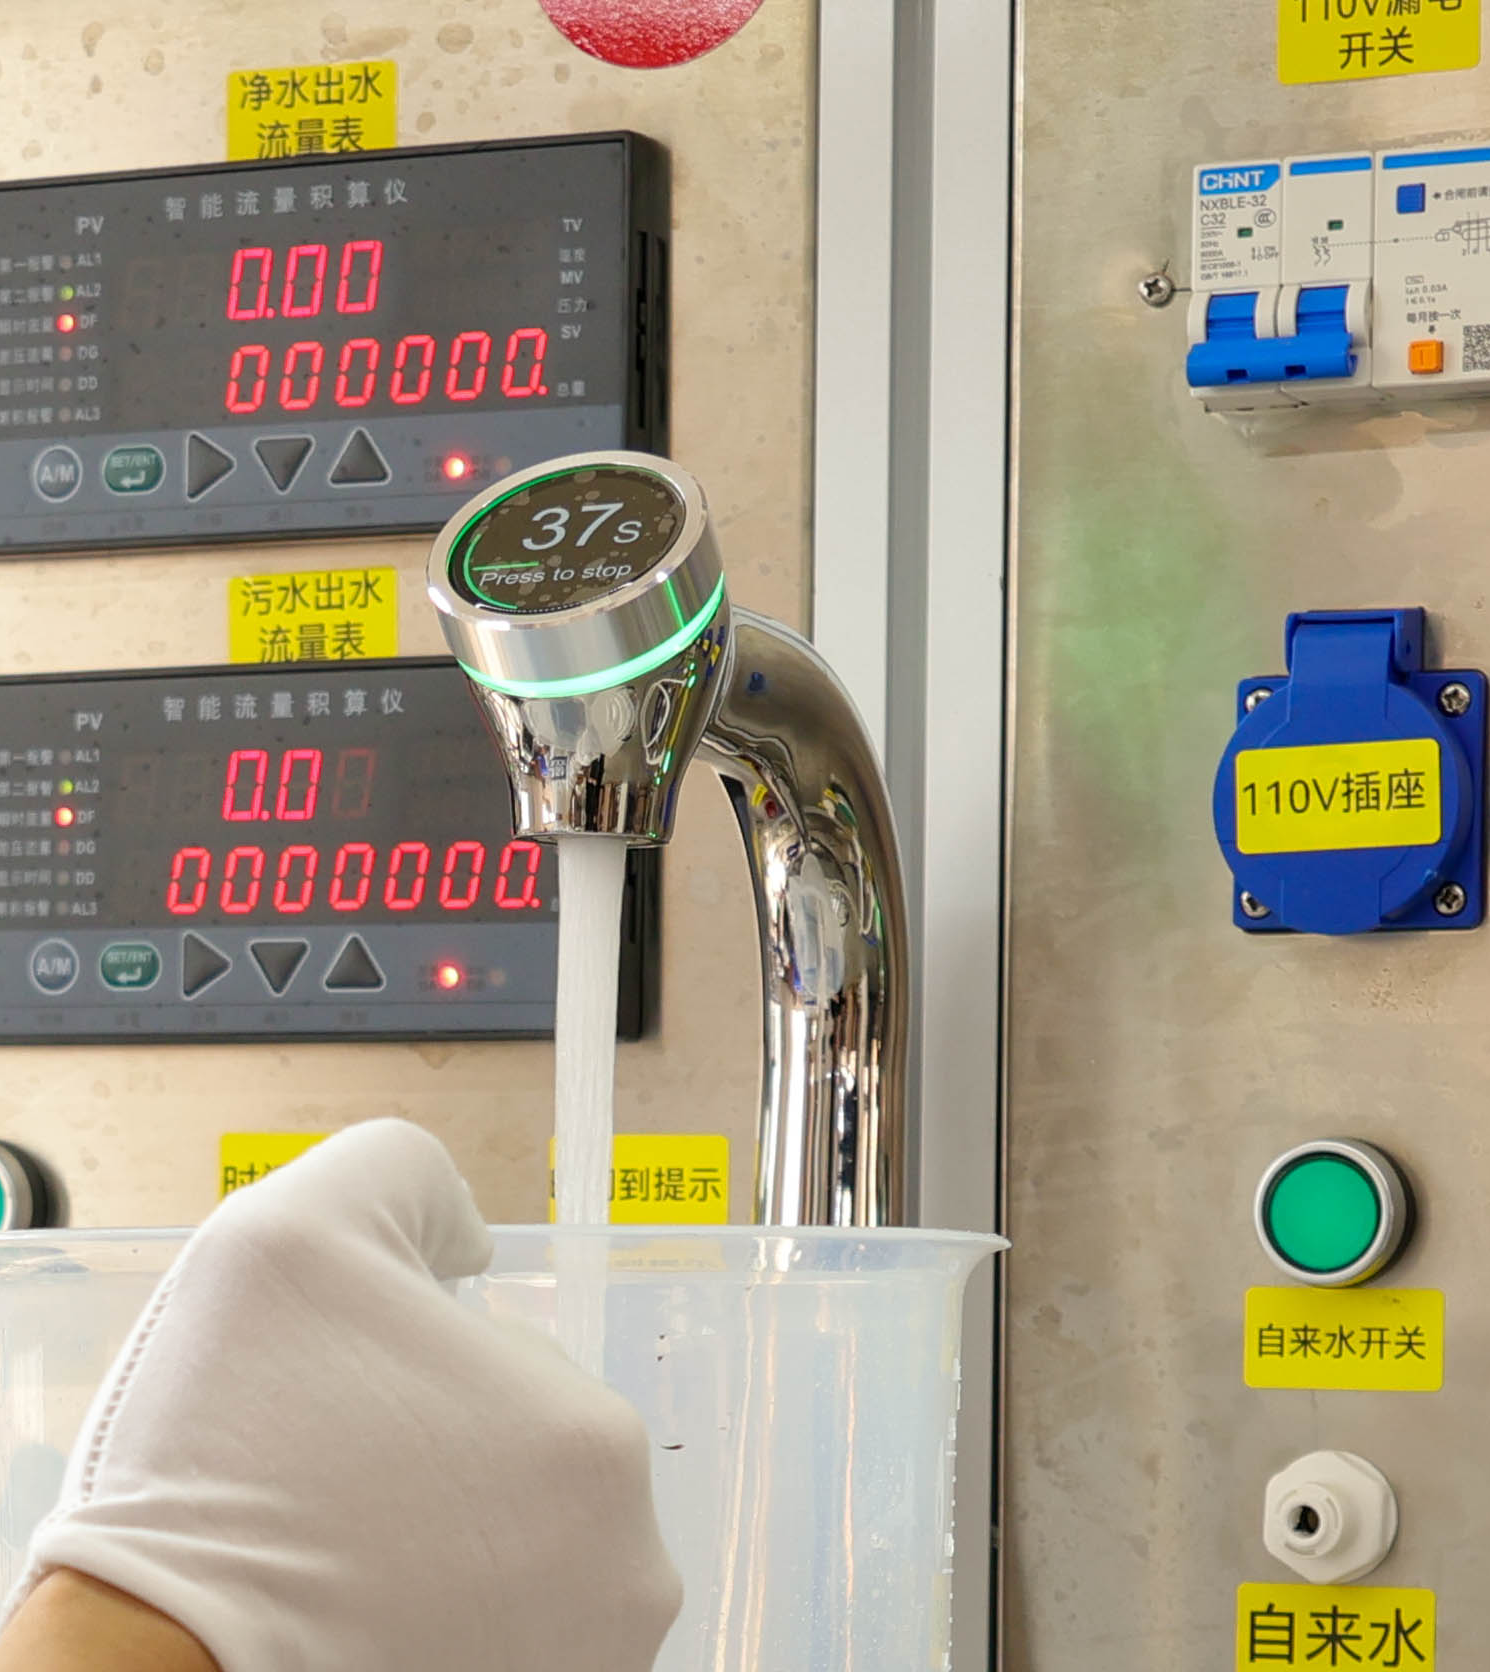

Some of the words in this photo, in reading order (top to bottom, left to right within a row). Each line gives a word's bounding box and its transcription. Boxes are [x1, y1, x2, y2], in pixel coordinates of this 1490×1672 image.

[1338, 26, 1414, 70] 开关
[239, 67, 384, 110] 净水出水
[256, 117, 366, 155] 流量表
[1200, 194, 1268, 212] NXBLE-32
[76, 216, 104, 236] PV
[562, 217, 583, 233] TV
[1200, 212, 1227, 227] C32
[225, 238, 384, 322] 0.00
[560, 270, 584, 285] MV
[561, 324, 582, 339] SV
[39, 463, 76, 485] A/M
[478, 569, 546, 588] Press
[552, 567, 576, 582] to
[581, 561, 633, 582] stop
[240, 574, 384, 617] 污水出水
[258, 620, 367, 663] 流量表
[75, 712, 104, 732] PV
[222, 748, 323, 822] 0.0
[1242, 768, 1427, 816] 110V插座
[36, 956, 72, 977] A/M
[1256, 1324, 1426, 1362] 自来水开关
[1247, 1602, 1426, 1670] 自来水
